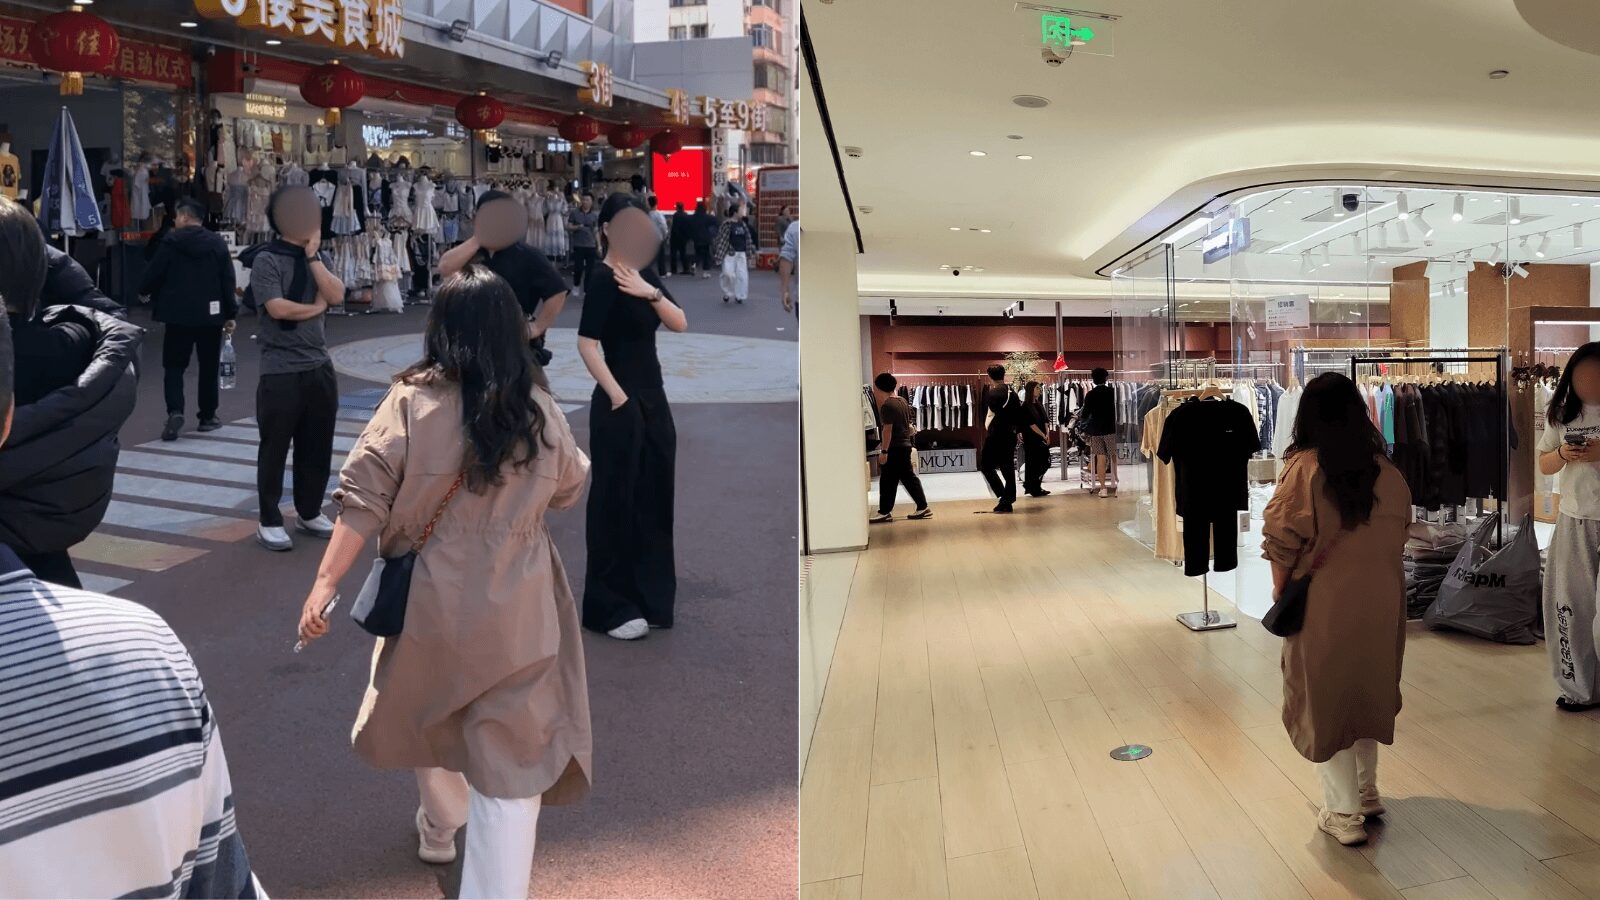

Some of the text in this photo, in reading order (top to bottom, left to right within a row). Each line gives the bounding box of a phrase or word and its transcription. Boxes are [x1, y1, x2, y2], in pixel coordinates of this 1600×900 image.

[221, 0, 405, 58] 楼美食城
[119, 47, 186, 81] 启动仪式
[591, 61, 613, 107] 3街
[704, 96, 767, 132] 5至9街
[88, 214, 97, 225] 5
[920, 454, 964, 468] MUYI
